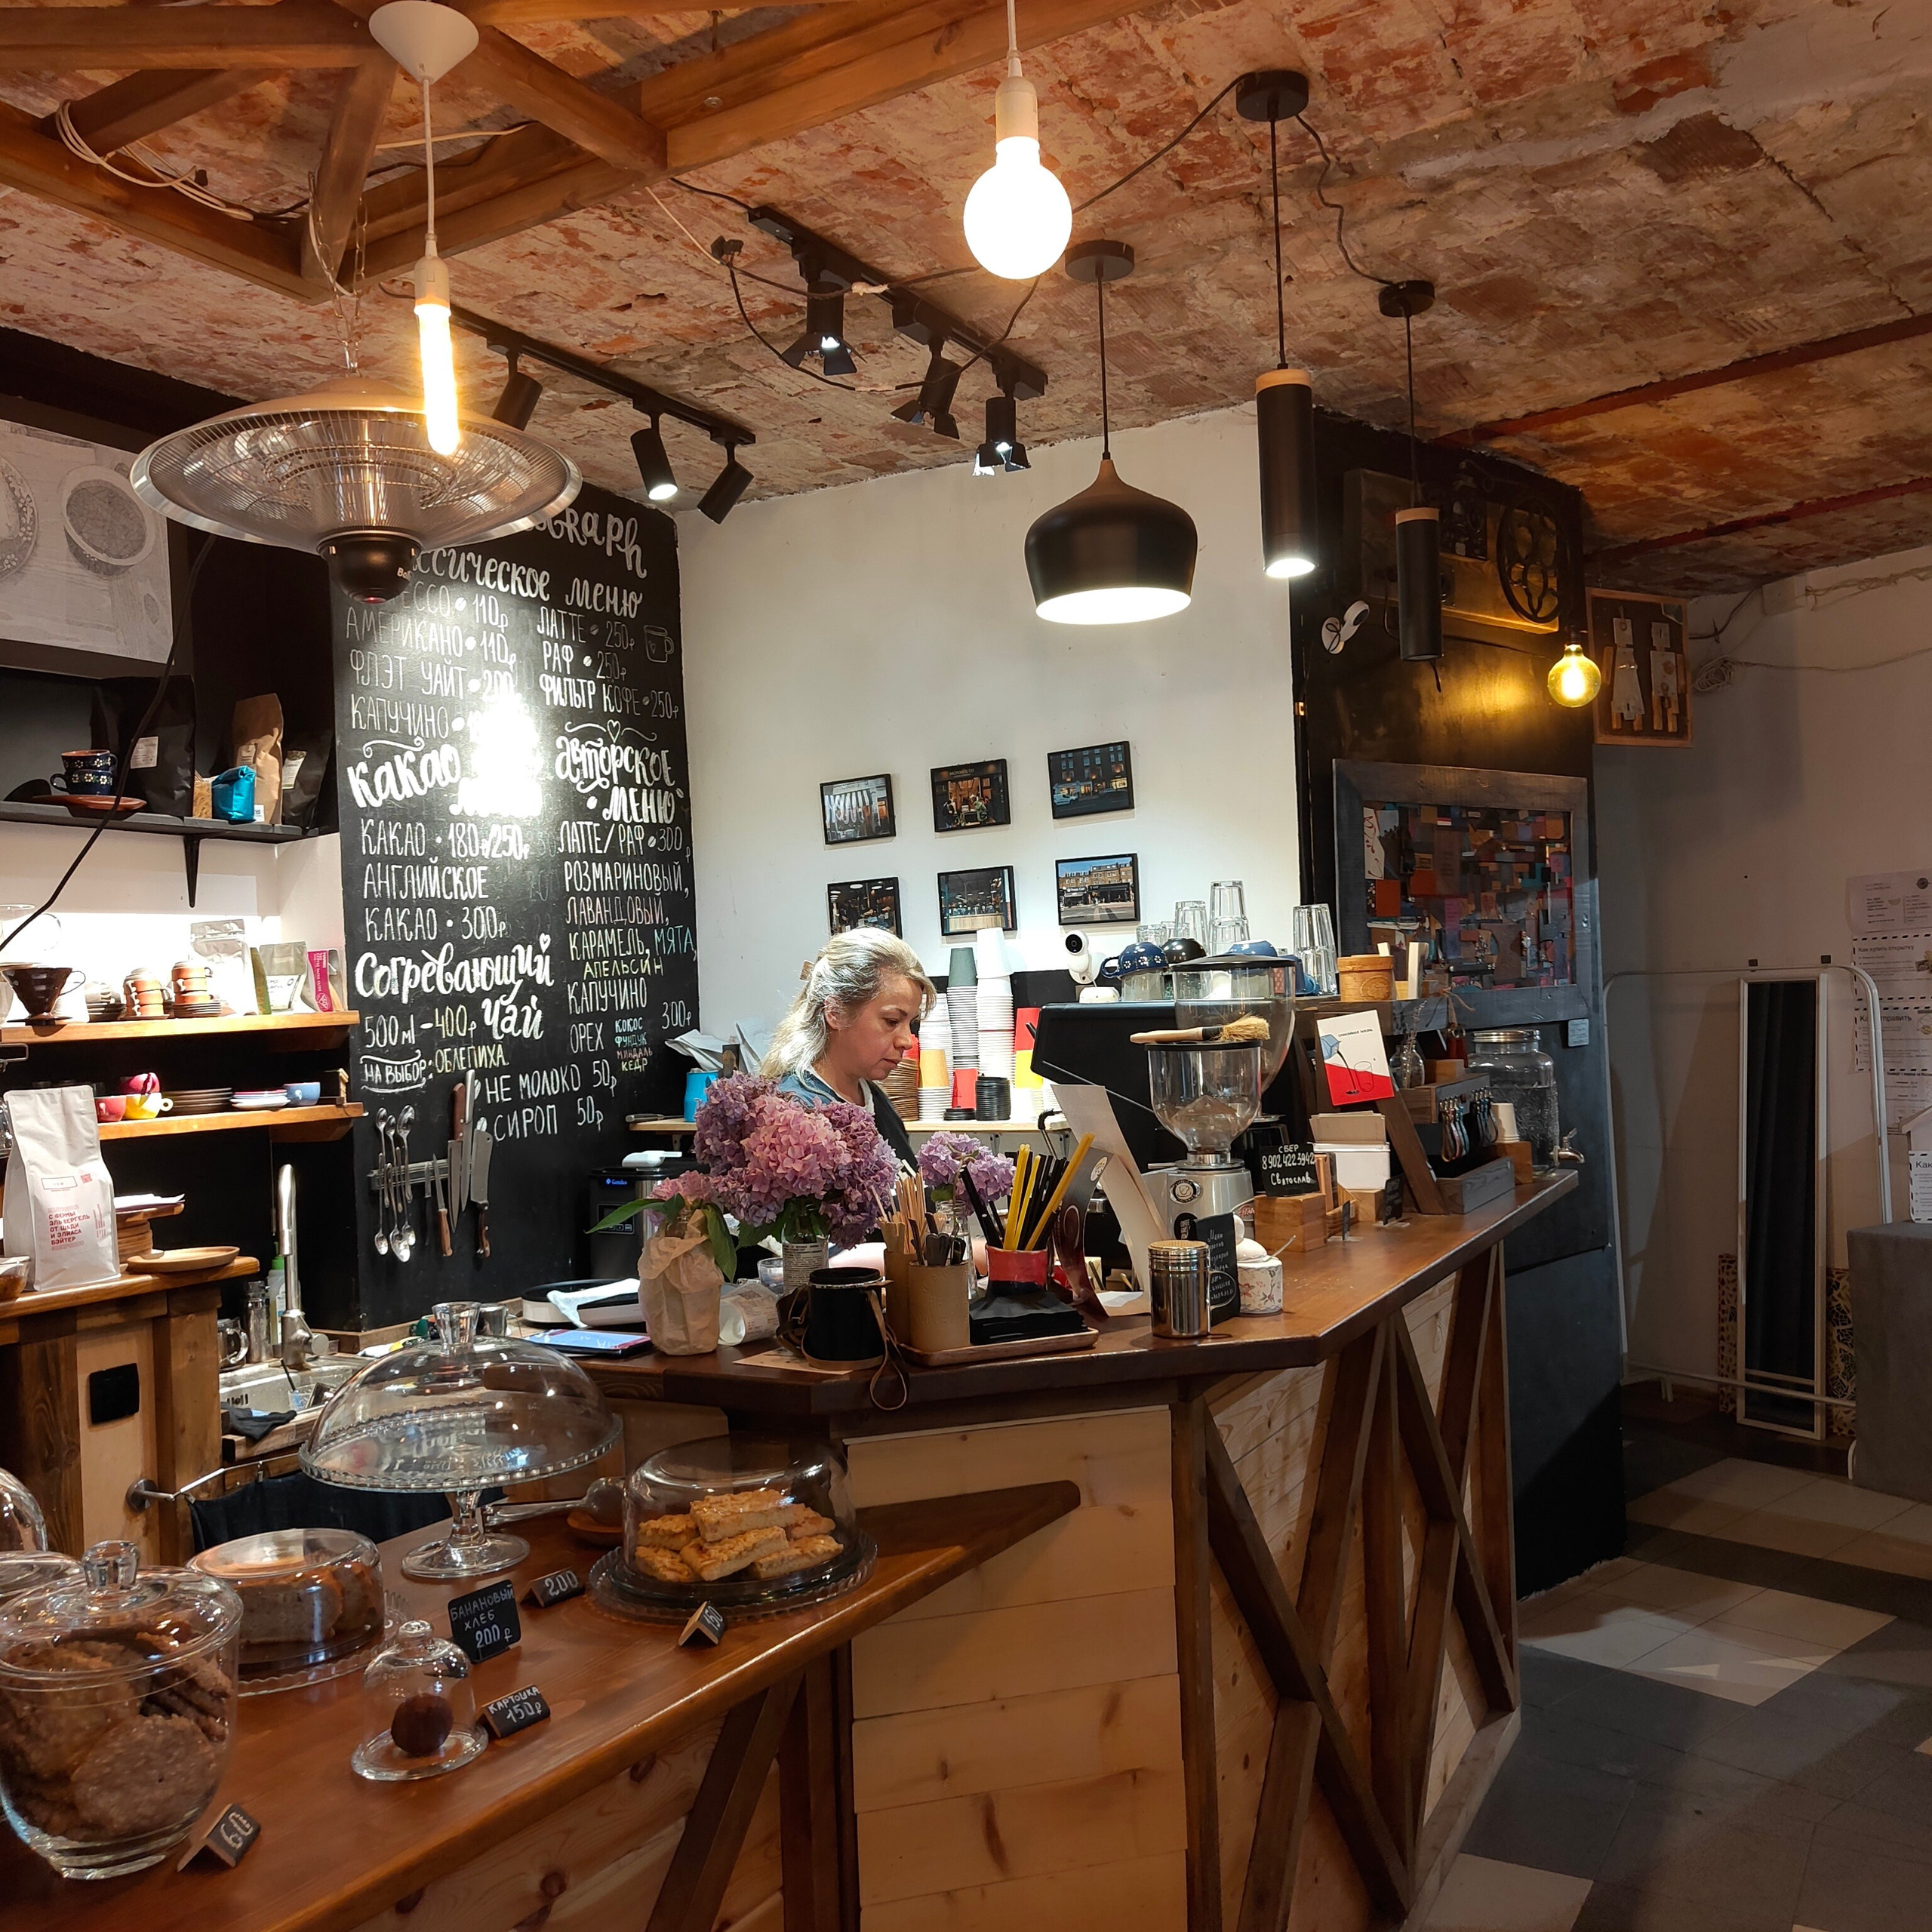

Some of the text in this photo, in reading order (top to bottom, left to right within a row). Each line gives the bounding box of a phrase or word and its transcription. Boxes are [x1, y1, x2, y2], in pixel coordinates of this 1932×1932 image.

[413, 548, 549, 601] ссическое
[346, 606, 463, 658] АМЕРИКАНО
[537, 606, 586, 643] ЛАТТЕ
[350, 649, 407, 691] ФЛЭТ
[421, 658, 467, 700] УАЙТ
[543, 640, 574, 675] РАФ
[539, 673, 596, 709] ФИЛЬТР
[602, 683, 641, 715] КОФЕ
[352, 694, 449, 739] КАПУЧИНО
[361, 818, 426, 857] КАКАО
[364, 856, 489, 900] АНГЛИЙСКОЕ
[564, 860, 689, 898] РОЗМАРИНОВЫЙ,
[365, 906, 438, 942] КАКАО
[565, 891, 669, 926] ЛАВАНДОВЫЙ,
[568, 928, 651, 961] КАРАМЕЛЬ,
[583, 956, 664, 980] АПЕЛЬСИН
[568, 977, 648, 1014] КАПУЧИНО
[570, 1023, 604, 1054] ОРЕХ
[614, 1017, 643, 1033] КОКОС
[614, 1032, 648, 1048] ФУНДУК
[617, 1047, 654, 1060] МИНДАЛЬ
[621, 1057, 648, 1072] КЕДР
[364, 1063, 382, 1084] НА
[485, 1075, 512, 1104] НЕ
[518, 1063, 581, 1100] МОЛОКО
[494, 1104, 558, 1142] СИРОП
[1278, 1144, 1299, 1153] СБЕР
[51, 1237, 76, 1245] БЭЙТЕР
[57, 1229, 82, 1238] ЭЛИАСА
[545, 1571, 579, 1596] 200
[450, 1584, 515, 1622] БАНАНОВЫЙ
[464, 1609, 495, 1631] ХЛЕБ
[703, 1606, 723, 1631] 150
[488, 1686, 540, 1715] КАРТОШКА
